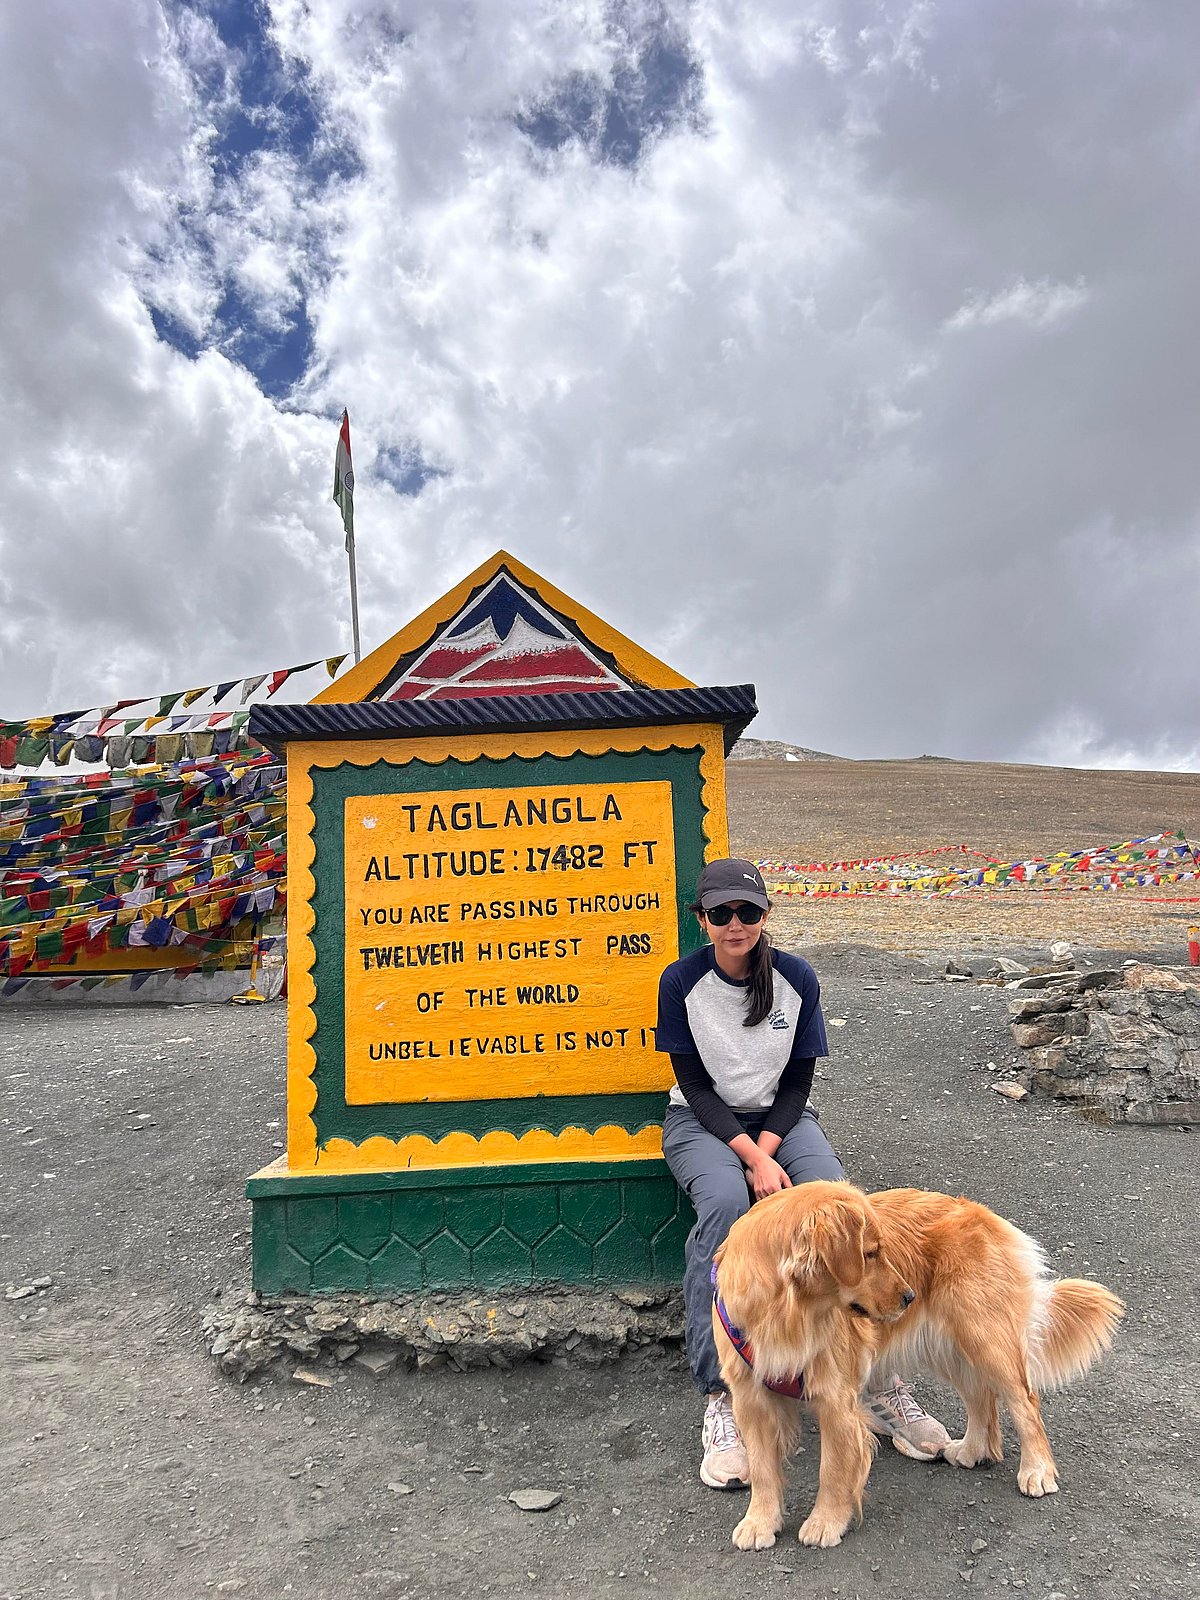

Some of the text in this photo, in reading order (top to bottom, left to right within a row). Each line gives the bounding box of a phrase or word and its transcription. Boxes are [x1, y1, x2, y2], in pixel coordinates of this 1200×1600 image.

[401, 794, 622, 833] TAGLANGLA
[623, 840, 658, 868] FT
[359, 892, 660, 926] YOU ARE PASSING THROUGH
[359, 933, 652, 971] TWELVETH HIGHEST PASS
[416, 983, 580, 1013] OF THE WORLD
[369, 1033, 545, 1061] UNBELIEVABLE
[556, 1031, 577, 1051] IS
[585, 1028, 629, 1050] NOT
